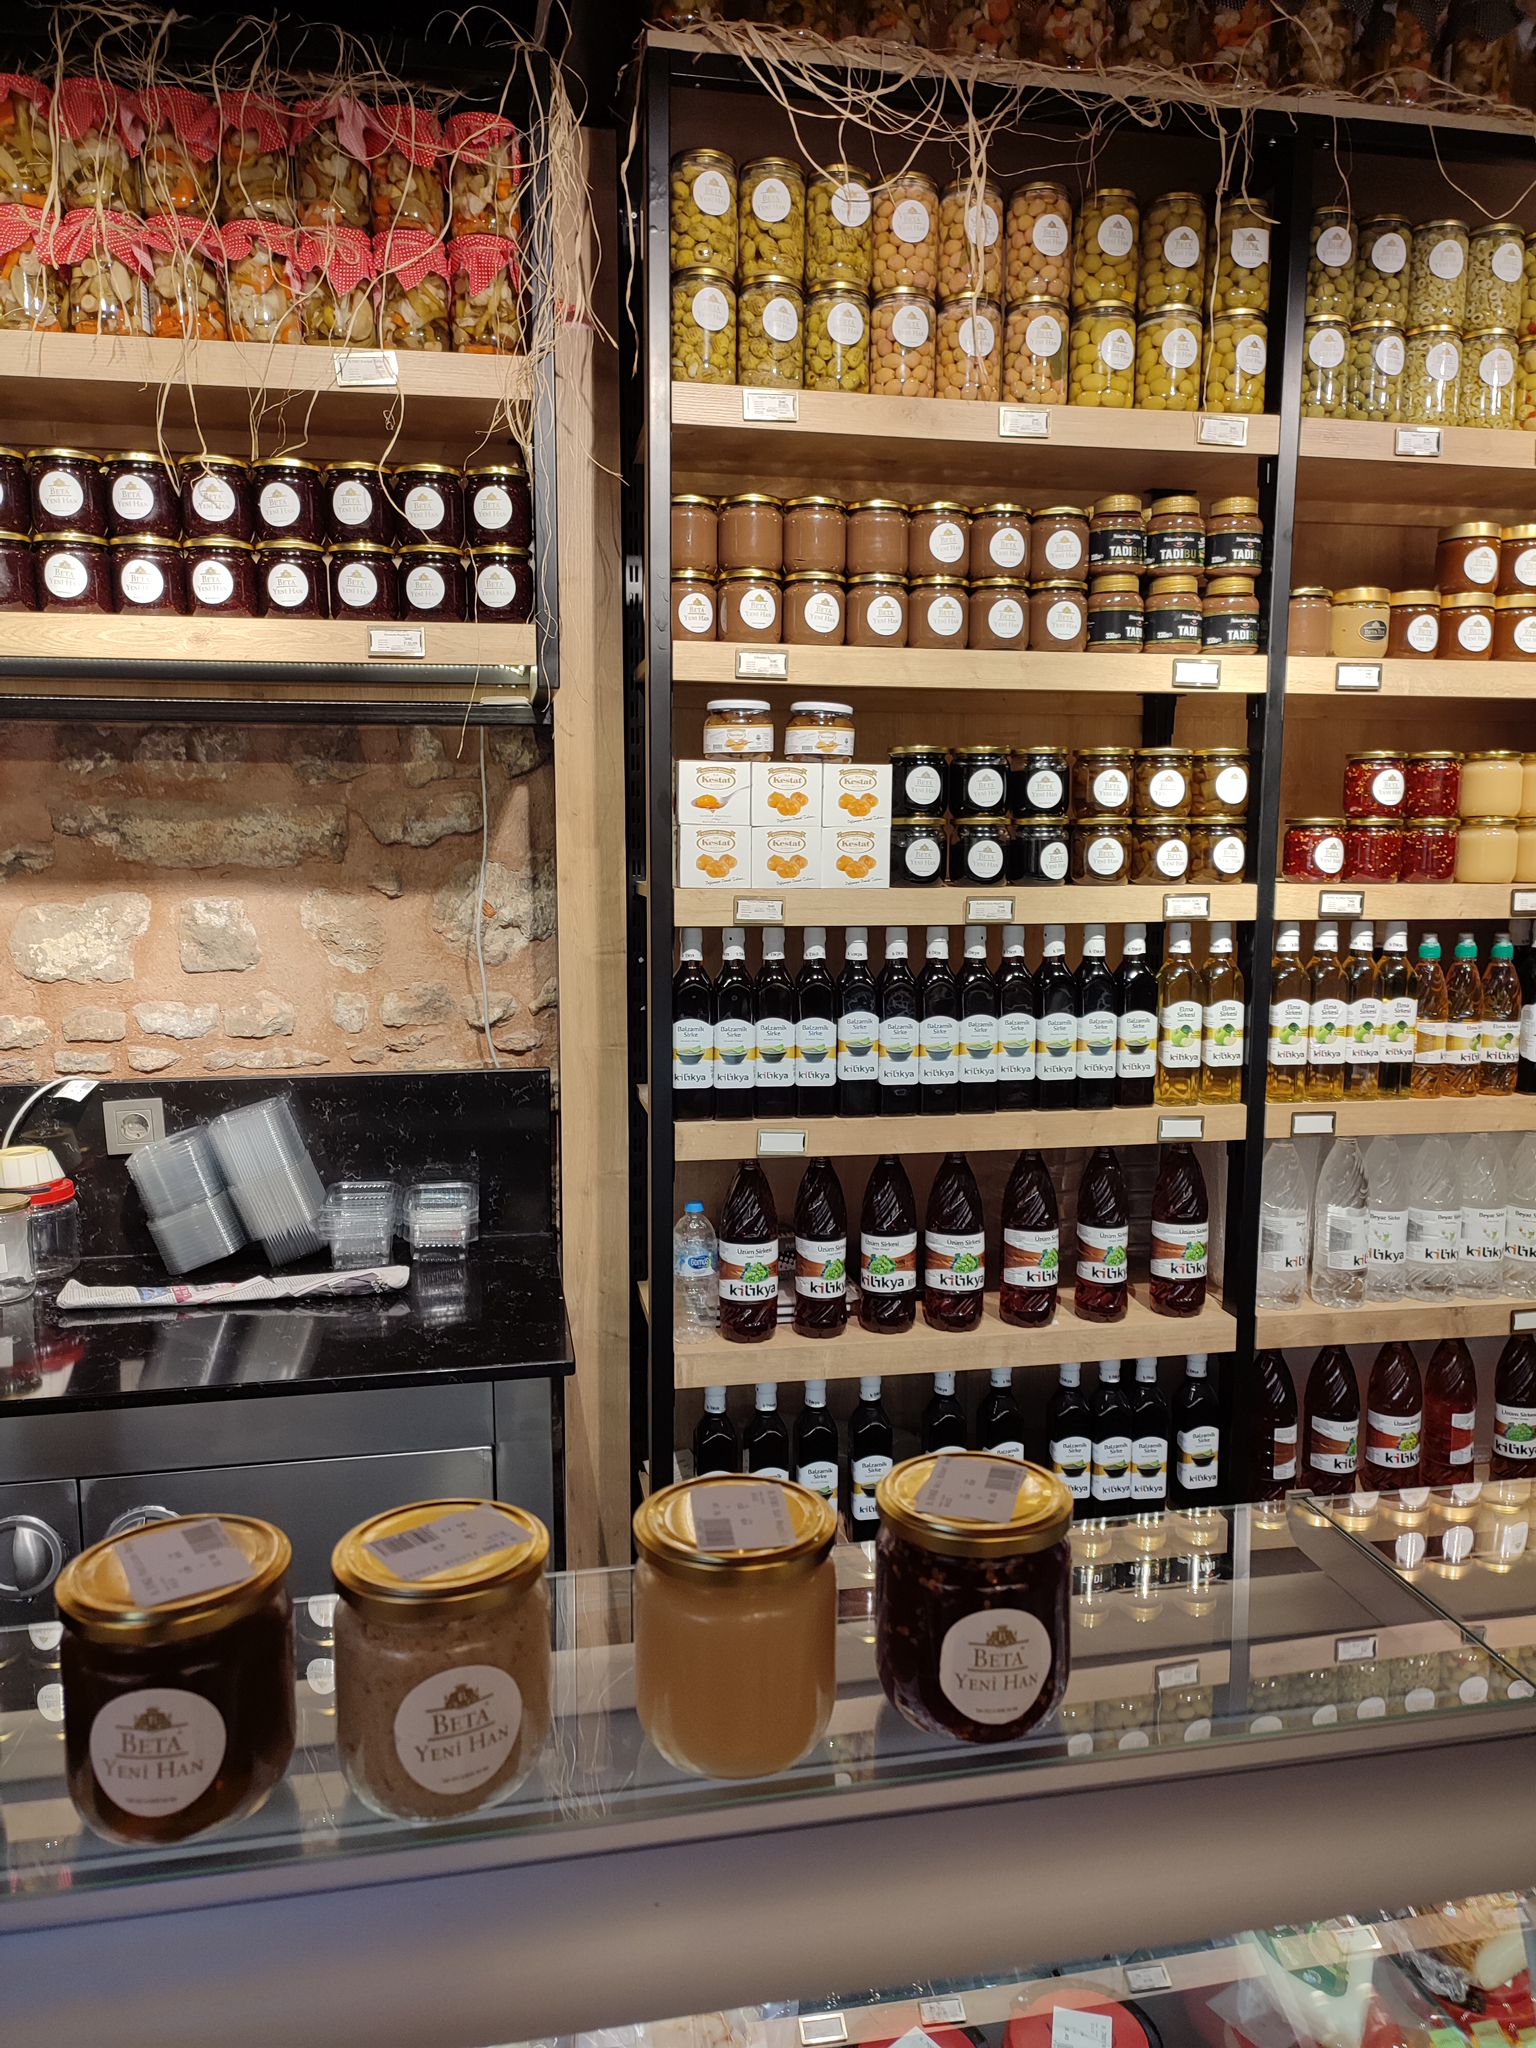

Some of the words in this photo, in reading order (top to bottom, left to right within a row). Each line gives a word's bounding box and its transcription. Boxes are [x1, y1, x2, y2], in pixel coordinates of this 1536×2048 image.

[1170, 1051, 1199, 1061] kilikya
[1213, 1051, 1241, 1061] kilikya
[1277, 1050, 1305, 1059] kilikya
[1313, 1049, 1341, 1059] kilikya
[1352, 1048, 1379, 1058] kilikya
[1385, 1048, 1412, 1057] kilikya
[843, 1064, 875, 1074] kilikya
[964, 1067, 995, 1076] kilikya
[1000, 1064, 1031, 1073] kilikya
[1043, 1064, 1073, 1073] kilikya
[1084, 1063, 1114, 1073] kilikya
[1122, 1062, 1151, 1072] kilikya
[674, 1072, 706, 1082] kilikya
[717, 1072, 749, 1082] kilikya
[757, 1071, 789, 1081] kilikya
[798, 1071, 830, 1080] kilikya
[883, 1069, 915, 1079] kilikya
[923, 1069, 955, 1078] kilikya
[1505, 1241, 1536, 1257] kilik
[1368, 1248, 1405, 1263] ilikya
[729, 1283, 776, 1298] kilikya
[1189, 1474, 1217, 1483] kilikya
[1134, 1484, 1163, 1493] kilikya
[973, 1648, 1024, 1668] BETA
[1003, 1672, 1039, 1691] HAN
[433, 1711, 491, 1736] BETA
[121, 1732, 182, 1754] BETA
[468, 1725, 509, 1753] HAN
[156, 1759, 205, 1780] HAN
